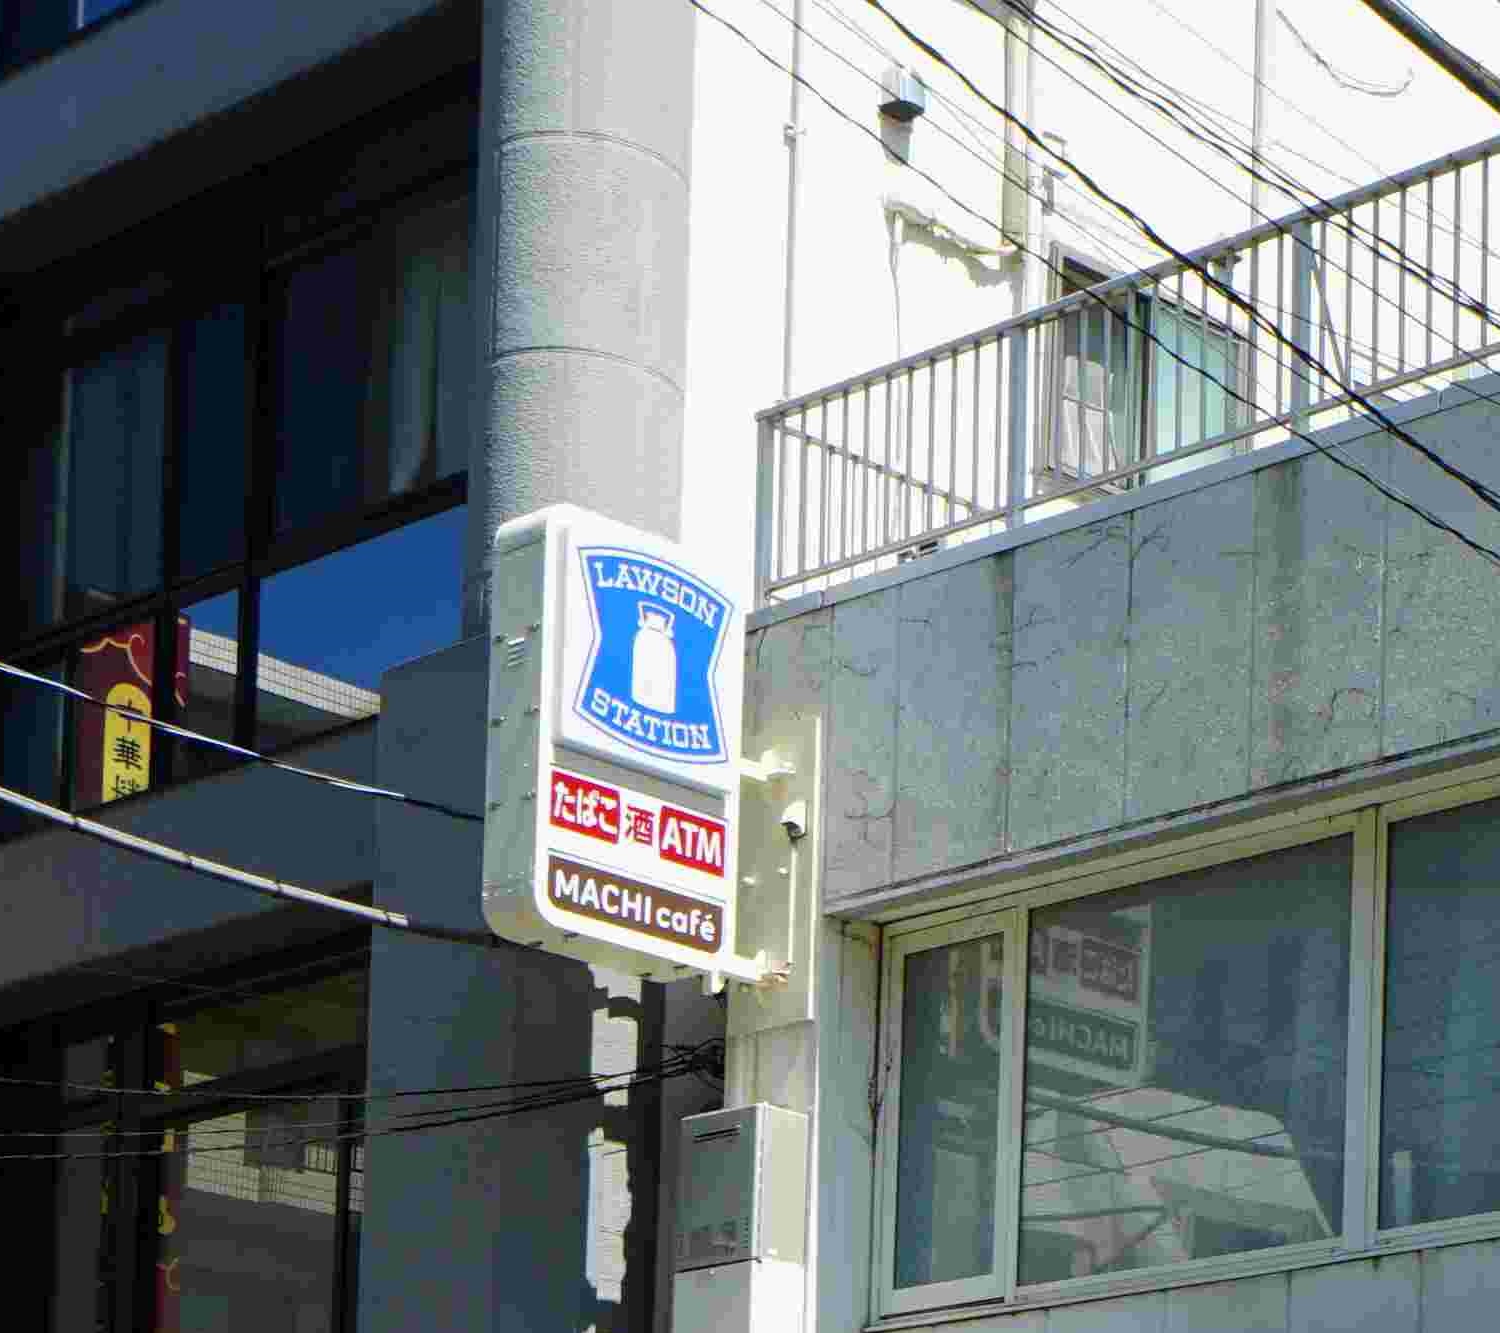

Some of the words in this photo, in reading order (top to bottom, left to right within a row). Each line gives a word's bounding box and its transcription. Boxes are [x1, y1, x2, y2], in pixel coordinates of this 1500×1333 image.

[594, 561, 720, 628] LAWSON
[591, 689, 713, 751] STATION
[553, 780, 618, 834] たばこ
[626, 807, 654, 847] 酒
[661, 816, 724, 867] ATM
[556, 868, 652, 925] MACHI
[657, 904, 717, 943] café
